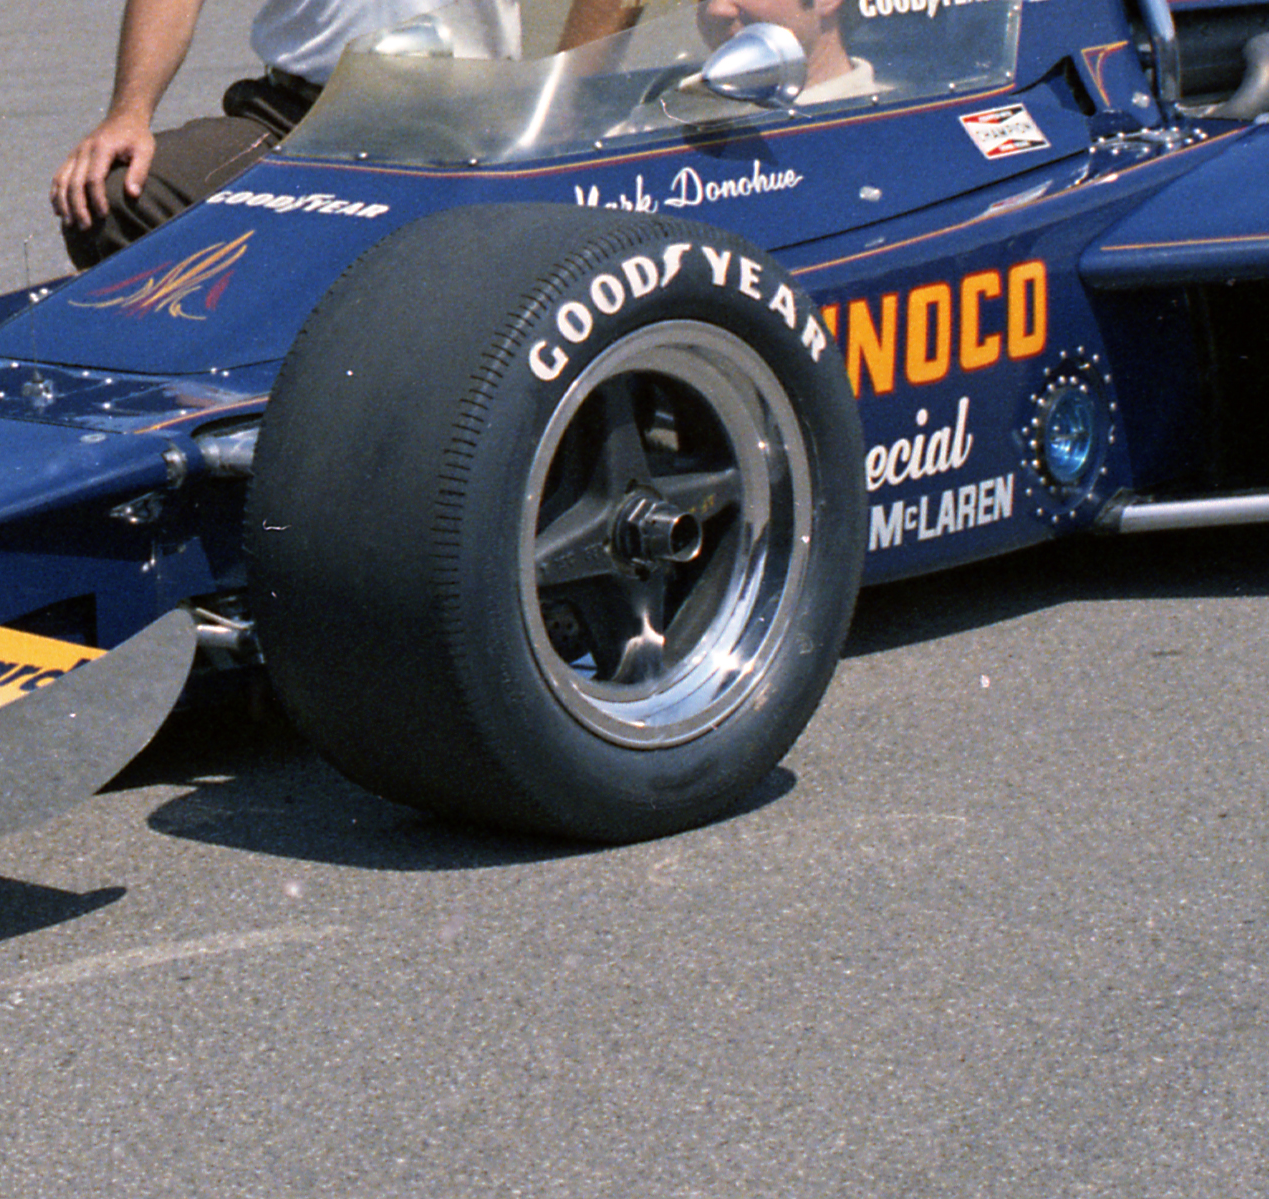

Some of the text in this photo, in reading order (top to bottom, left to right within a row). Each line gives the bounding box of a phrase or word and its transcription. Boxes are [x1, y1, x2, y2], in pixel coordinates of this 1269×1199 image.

[205, 191, 391, 219] GOODYEAR
[663, 159, 803, 207] Donohue
[528, 243, 828, 382] GOODYEAR
[821, 258, 1048, 400] NOCO
